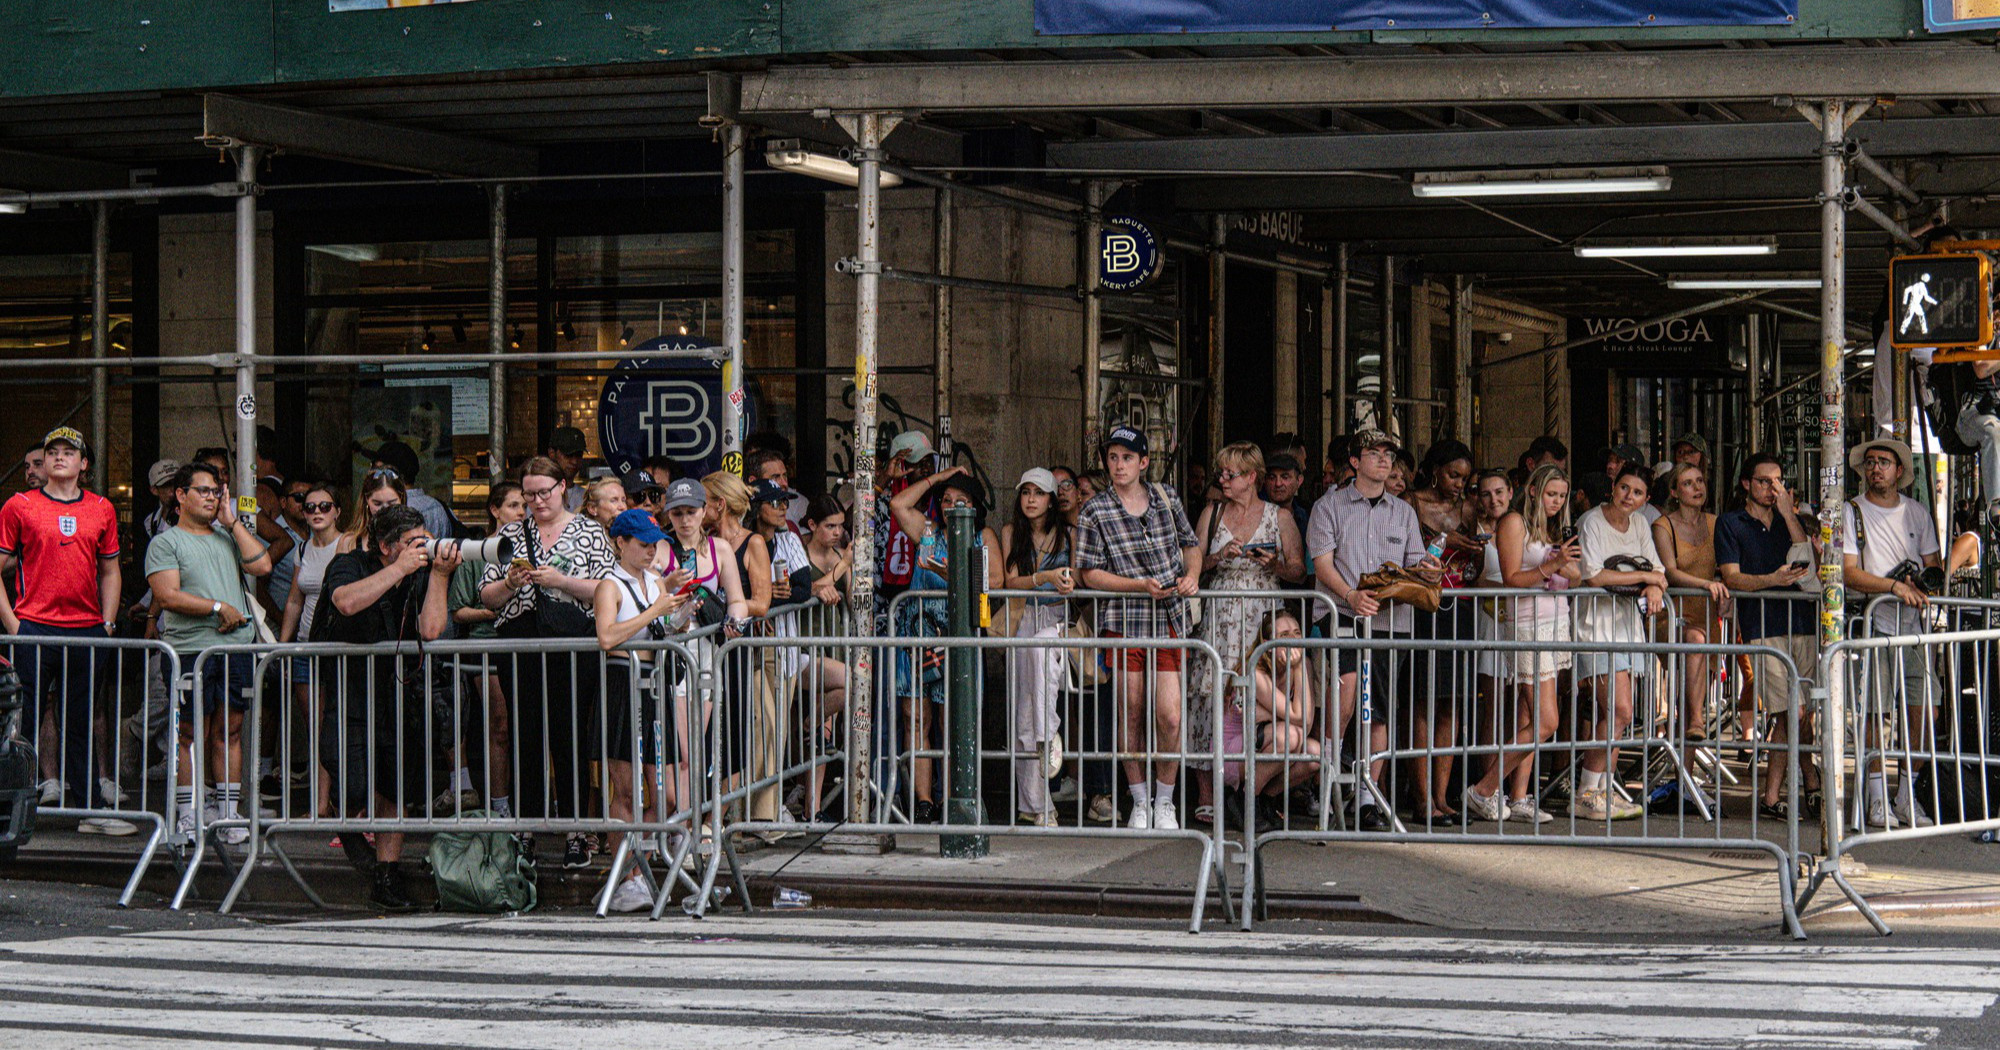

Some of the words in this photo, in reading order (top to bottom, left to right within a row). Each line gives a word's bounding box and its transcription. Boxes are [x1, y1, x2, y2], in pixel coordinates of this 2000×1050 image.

[1583, 317, 1713, 342] WOOGA
[1662, 345, 1693, 353] Lounge
[1361, 661, 1370, 721] NYPD
